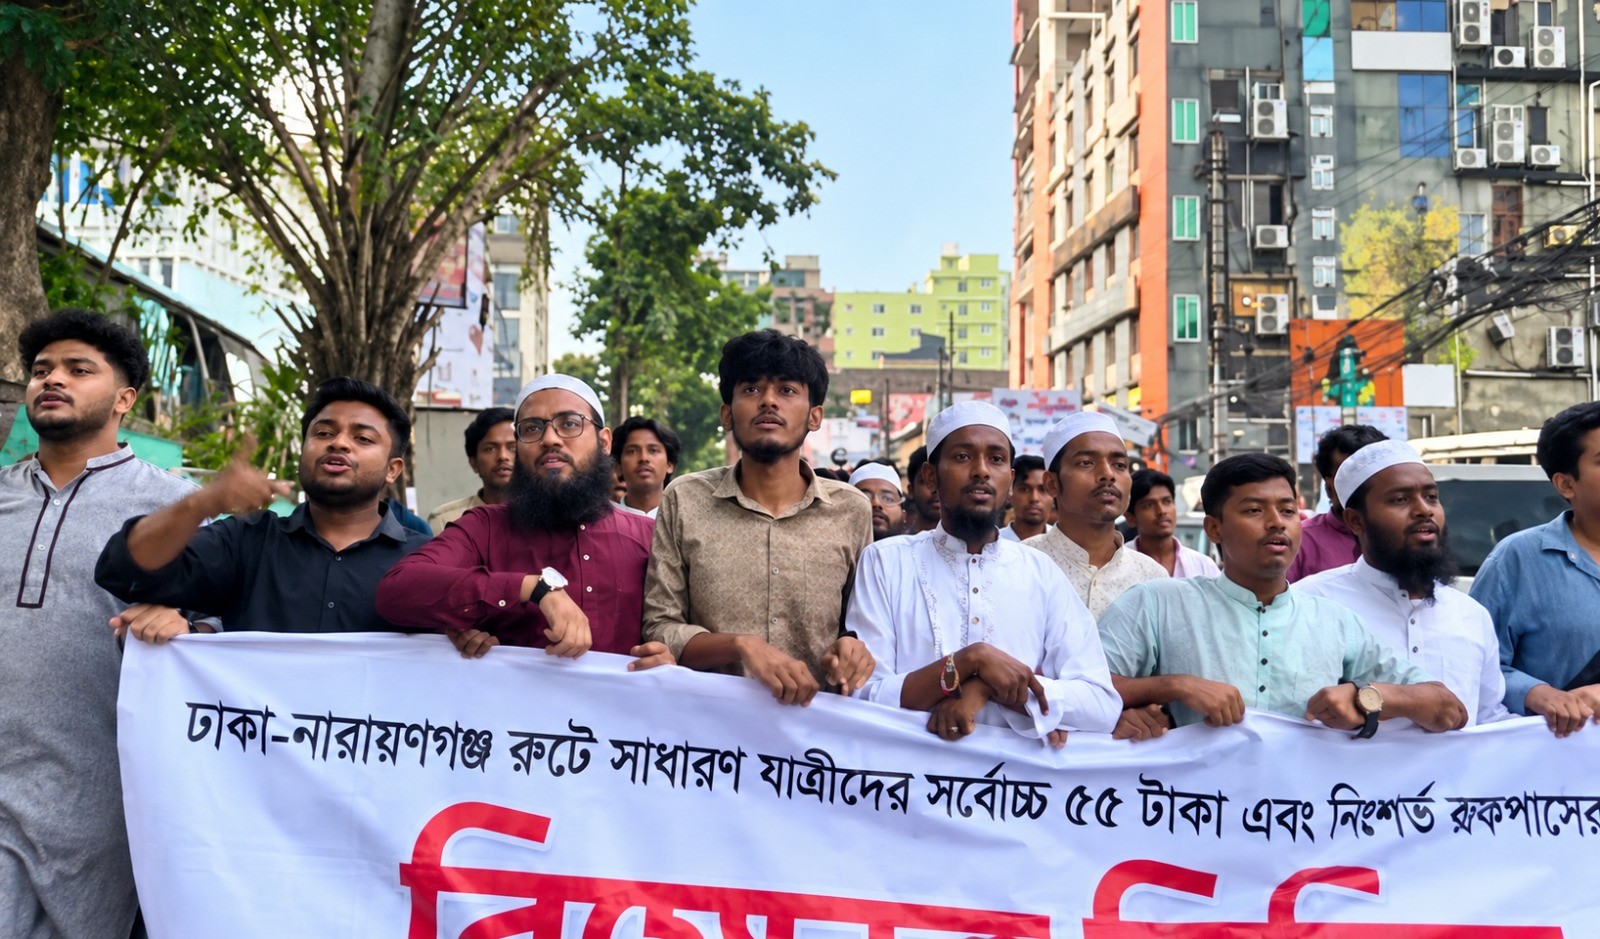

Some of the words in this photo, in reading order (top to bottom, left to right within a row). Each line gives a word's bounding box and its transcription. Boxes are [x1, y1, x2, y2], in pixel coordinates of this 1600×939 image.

[508, 719, 598, 776] রুটে
[609, 737, 747, 793] সাধারণ
[758, 748, 914, 814] যাত্রীদের
[925, 762, 1051, 821] সর্বোচ্চ
[1065, 785, 1123, 827] ৫৫
[1137, 773, 1229, 839] টাকা
[1243, 798, 1314, 843] এবং
